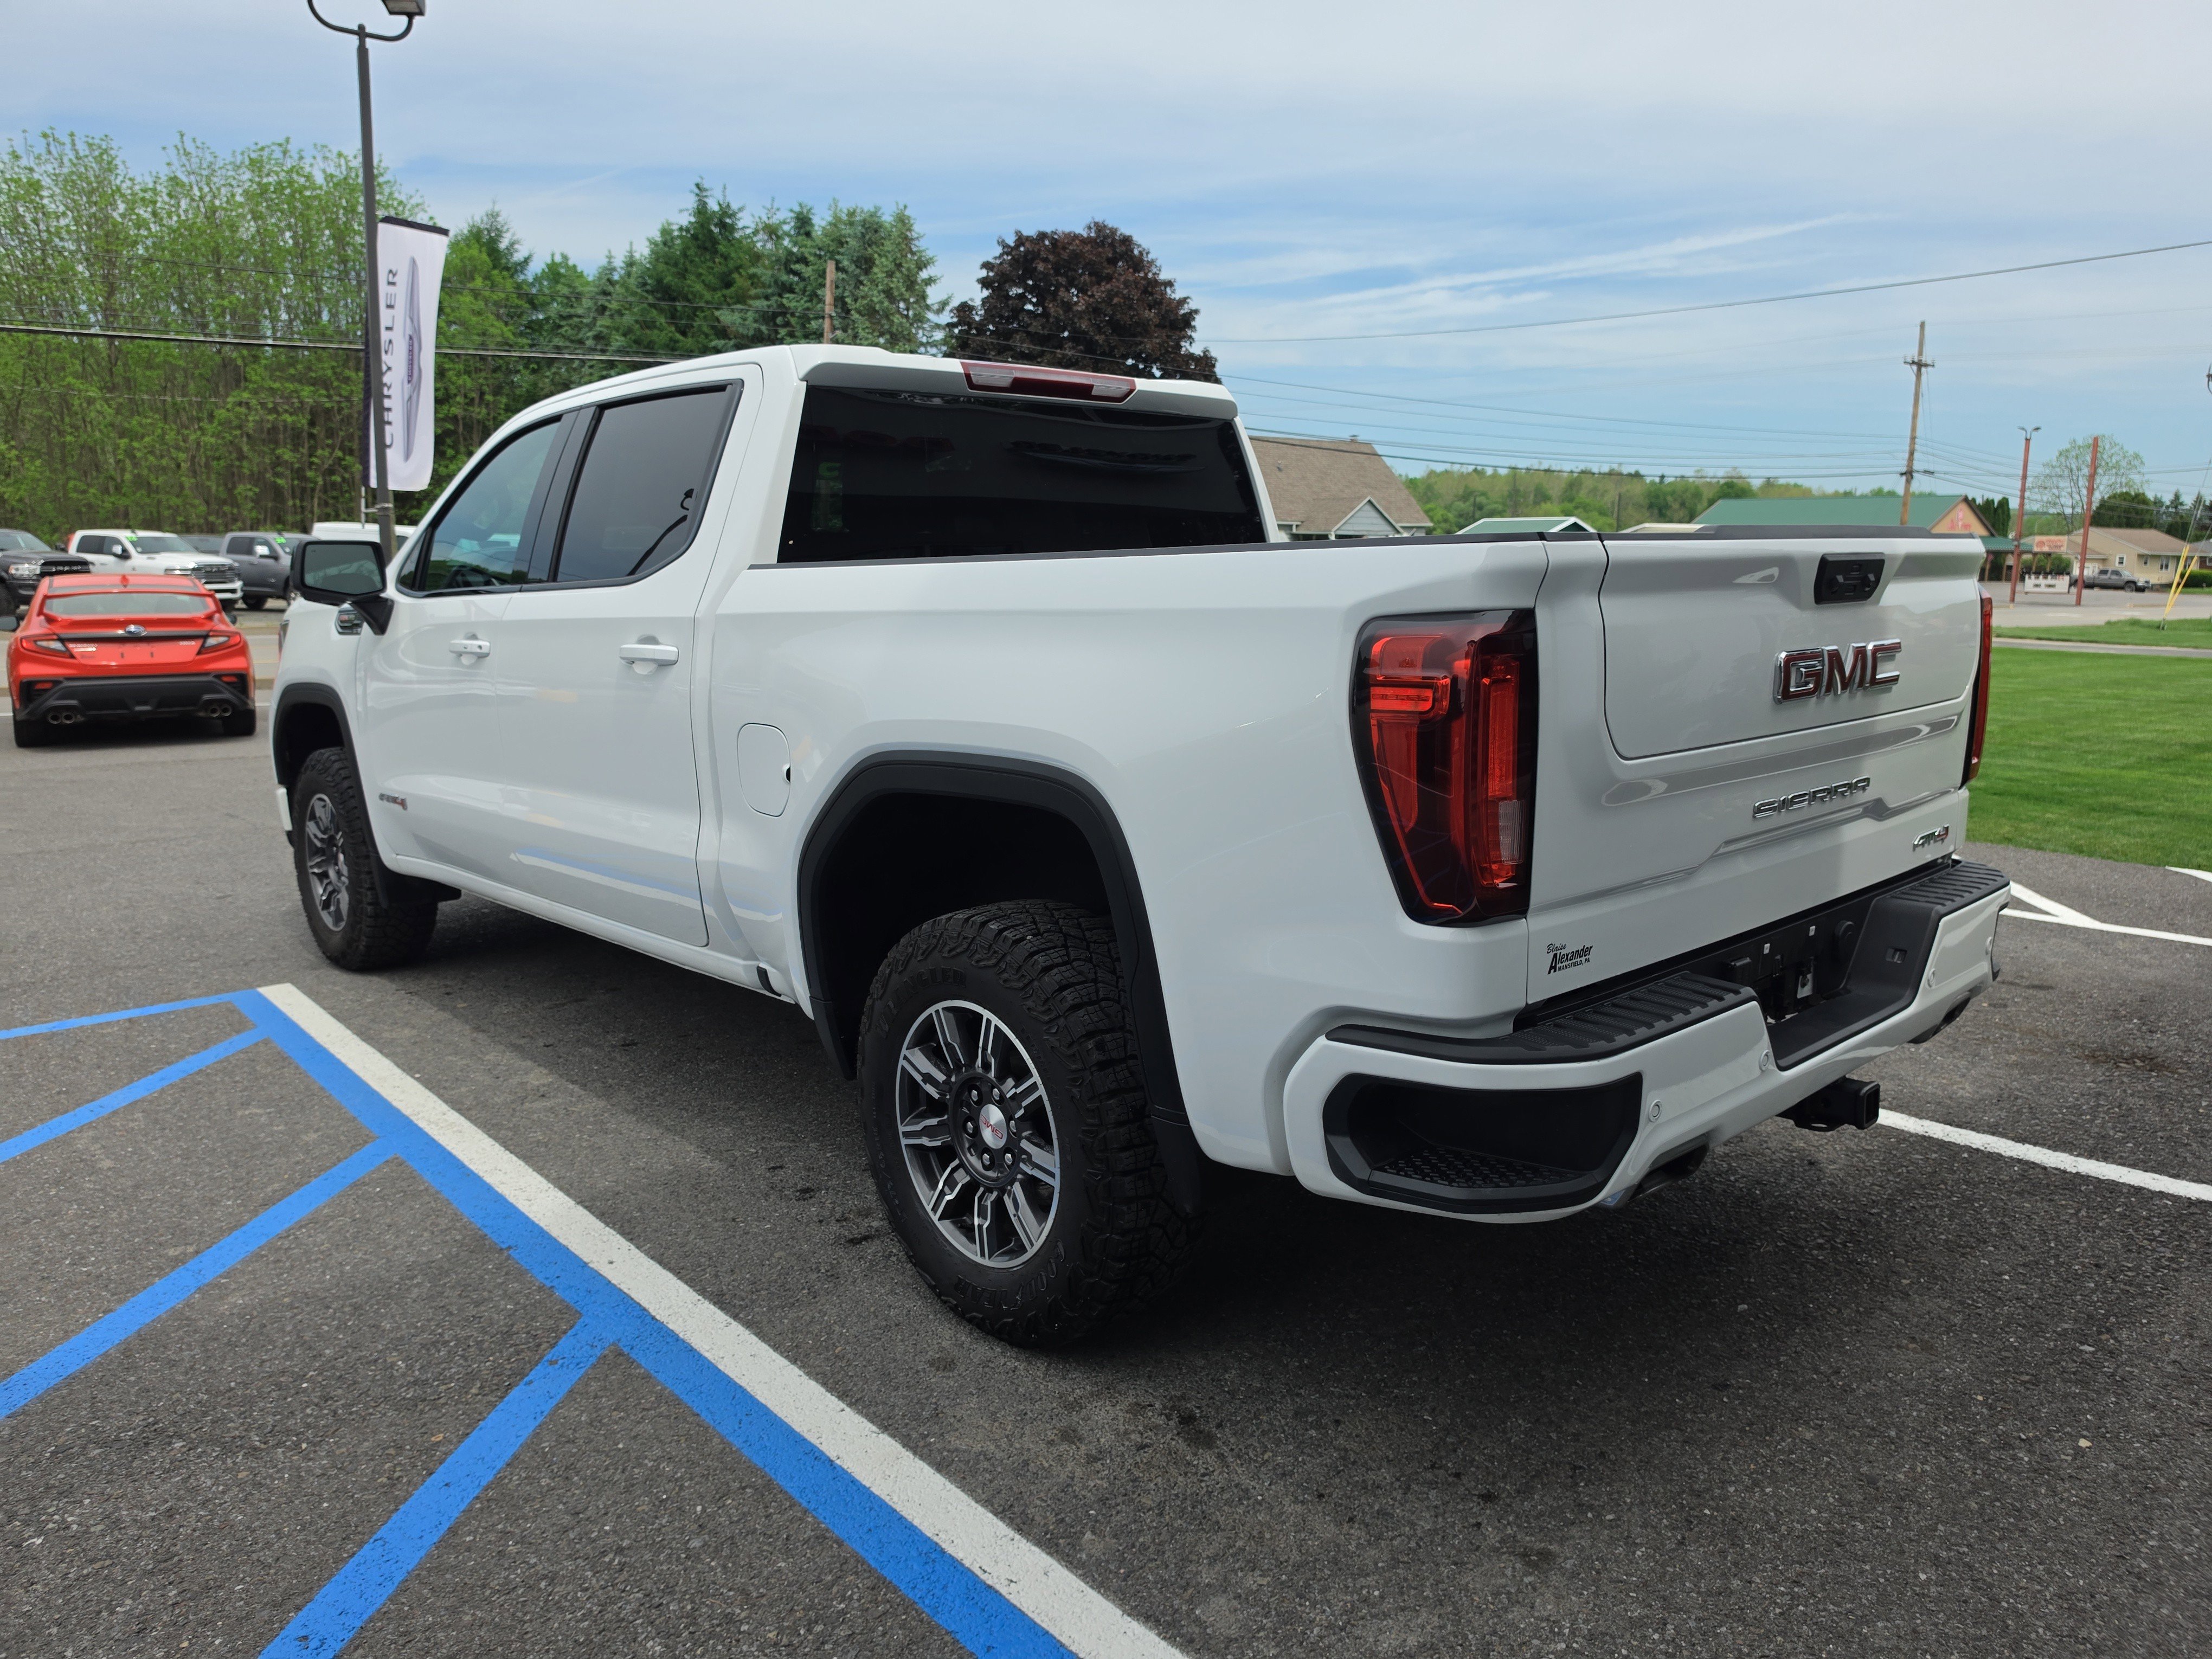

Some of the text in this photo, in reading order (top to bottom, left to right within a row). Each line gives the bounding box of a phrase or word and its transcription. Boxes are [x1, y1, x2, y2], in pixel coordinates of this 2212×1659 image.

[381, 268, 398, 449] CHRYSLER
[1773, 638, 1902, 704] GMC
[1753, 776, 1871, 819] SIERRA
[1547, 943, 1566, 954] Blaise
[1547, 945, 1593, 975] Alexander
[1558, 960, 1584, 972] MANSFIELD,
[875, 965, 967, 1040] WRANGLER
[980, 1114, 1004, 1140] GMC
[953, 1238, 1065, 1310] GOODYEAR
